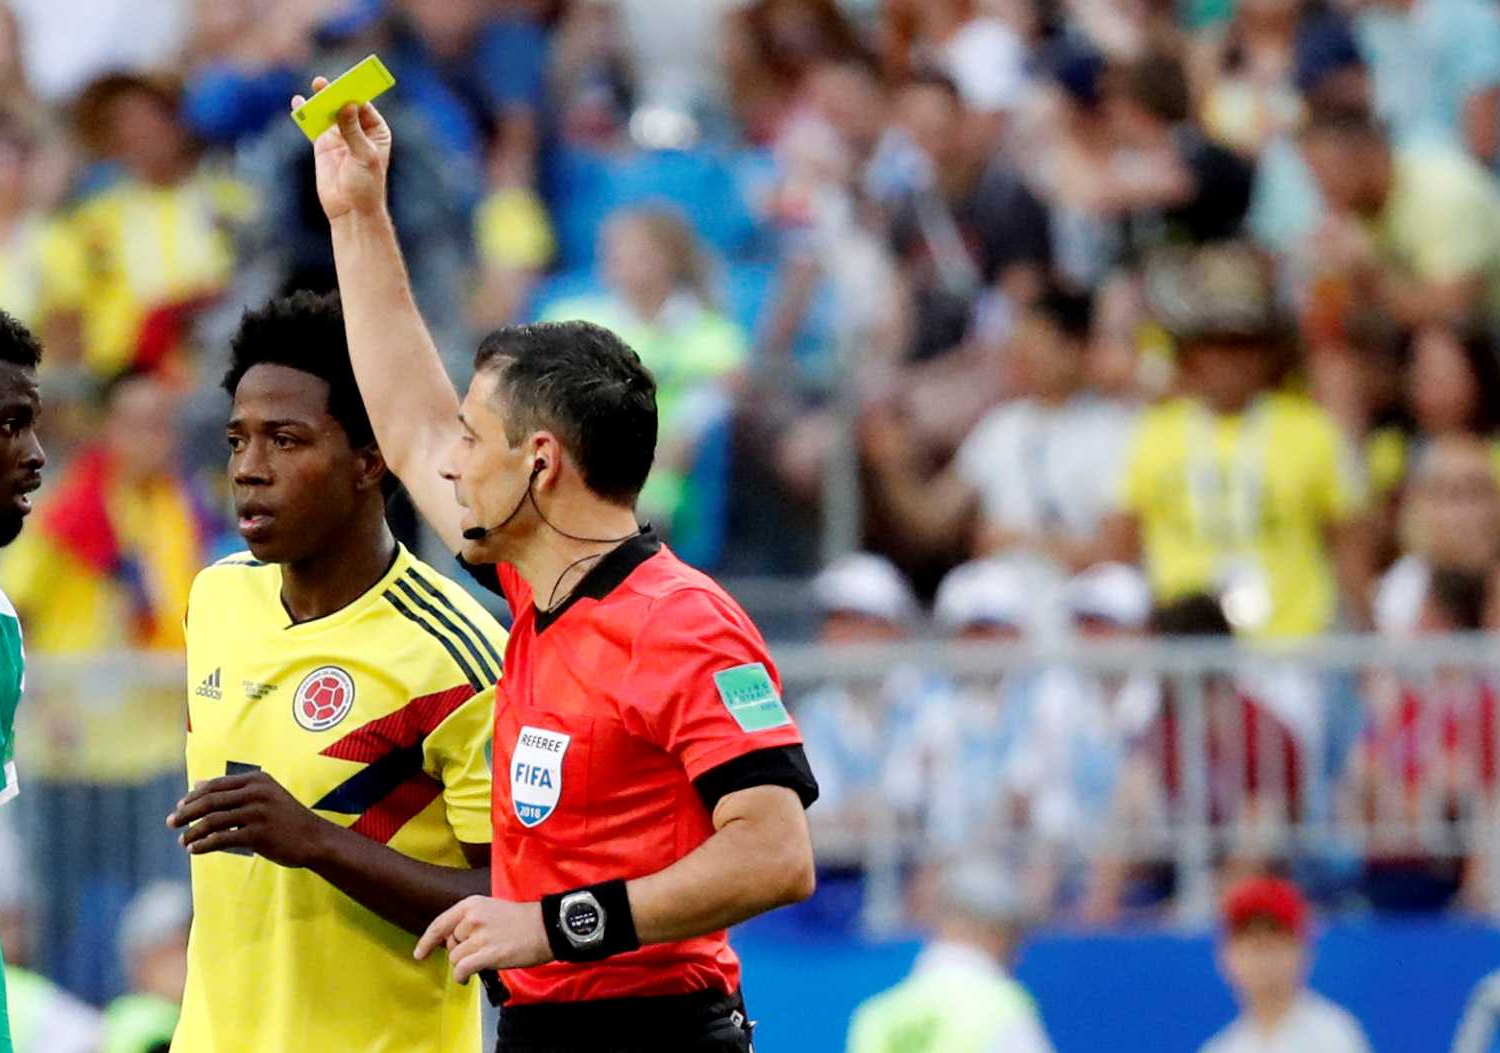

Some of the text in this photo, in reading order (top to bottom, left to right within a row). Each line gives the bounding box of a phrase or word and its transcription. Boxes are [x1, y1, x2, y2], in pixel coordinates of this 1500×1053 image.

[521, 734, 562, 752] REFEREE
[515, 762, 553, 789] FIFA
[520, 807, 541, 819] 2018
